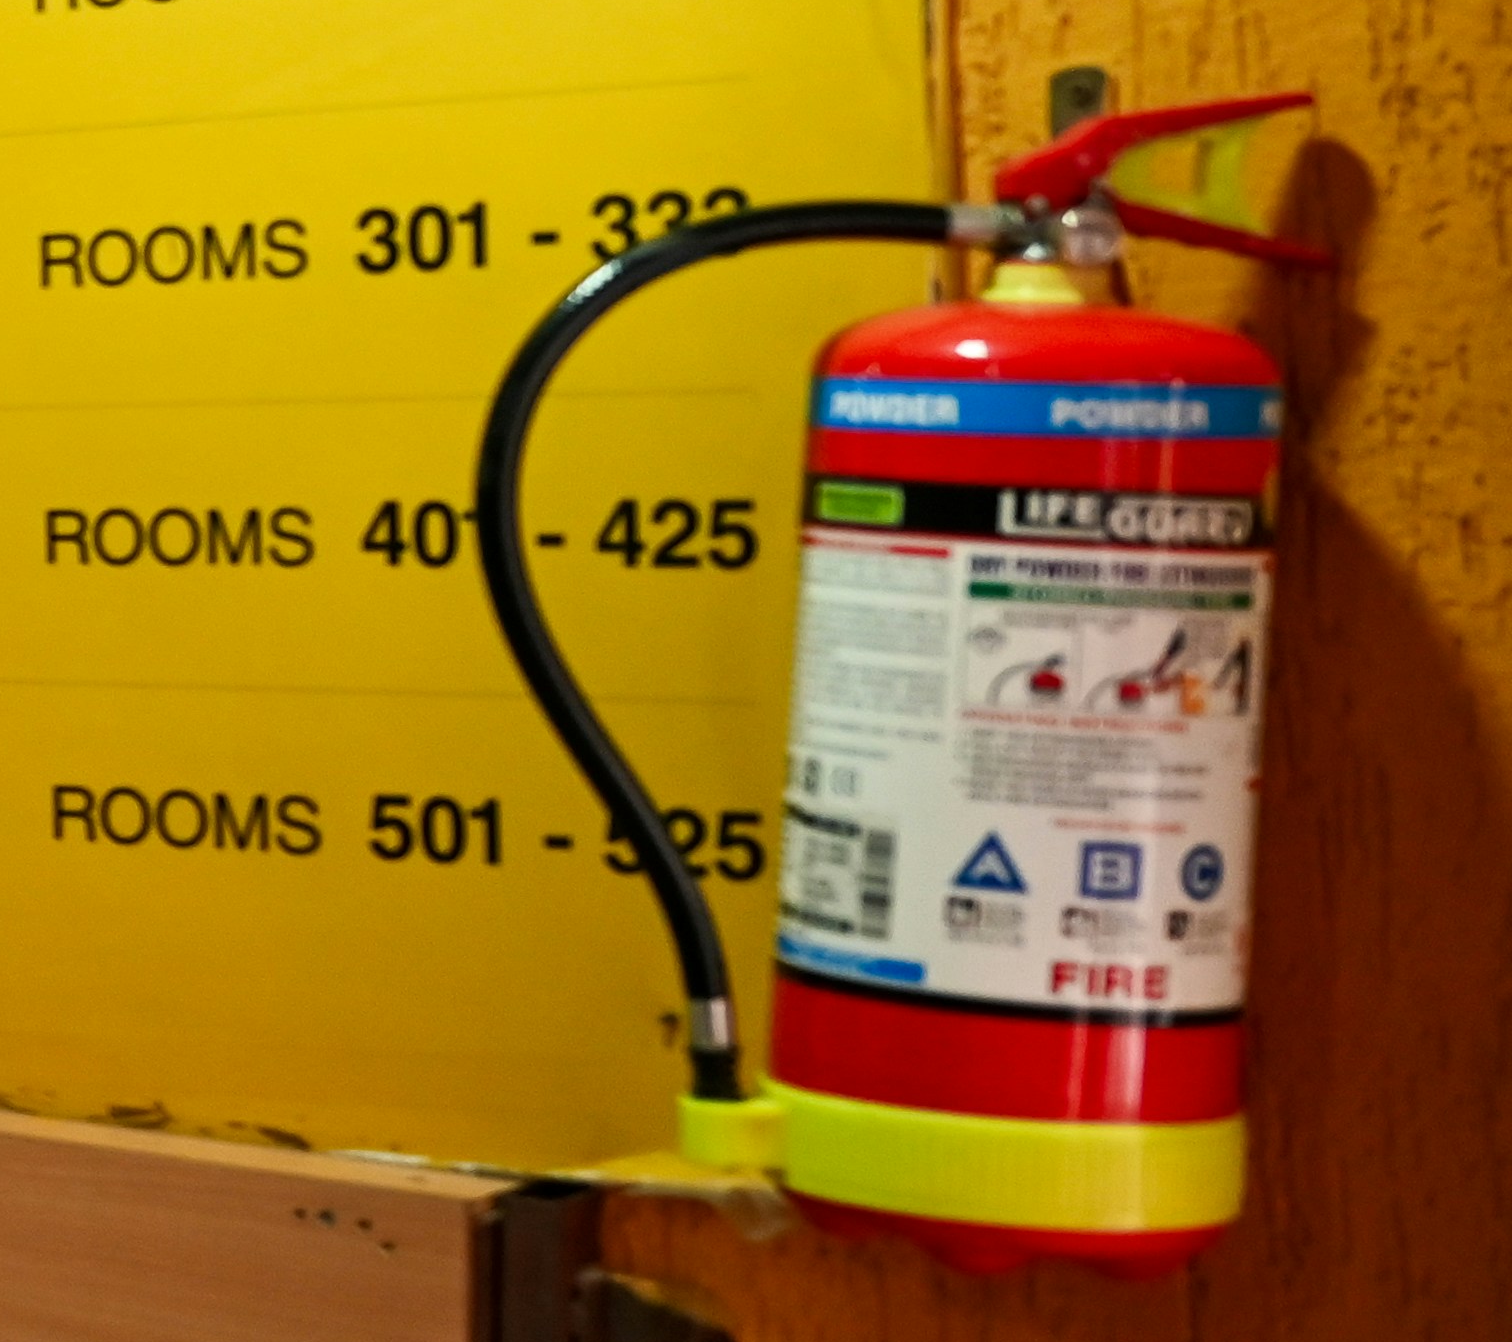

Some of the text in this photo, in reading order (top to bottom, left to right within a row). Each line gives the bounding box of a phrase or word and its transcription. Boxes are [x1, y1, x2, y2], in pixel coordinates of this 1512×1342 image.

[41, 220, 308, 290] ROOMS
[356, 201, 489, 274] 301
[530, 227, 559, 246] -
[46, 499, 759, 568] ROOMS 40 - 425
[53, 785, 322, 854] ROOMS
[369, 794, 503, 864] 501
[545, 835, 572, 850] -
[1050, 961, 1170, 1001] FIRE
